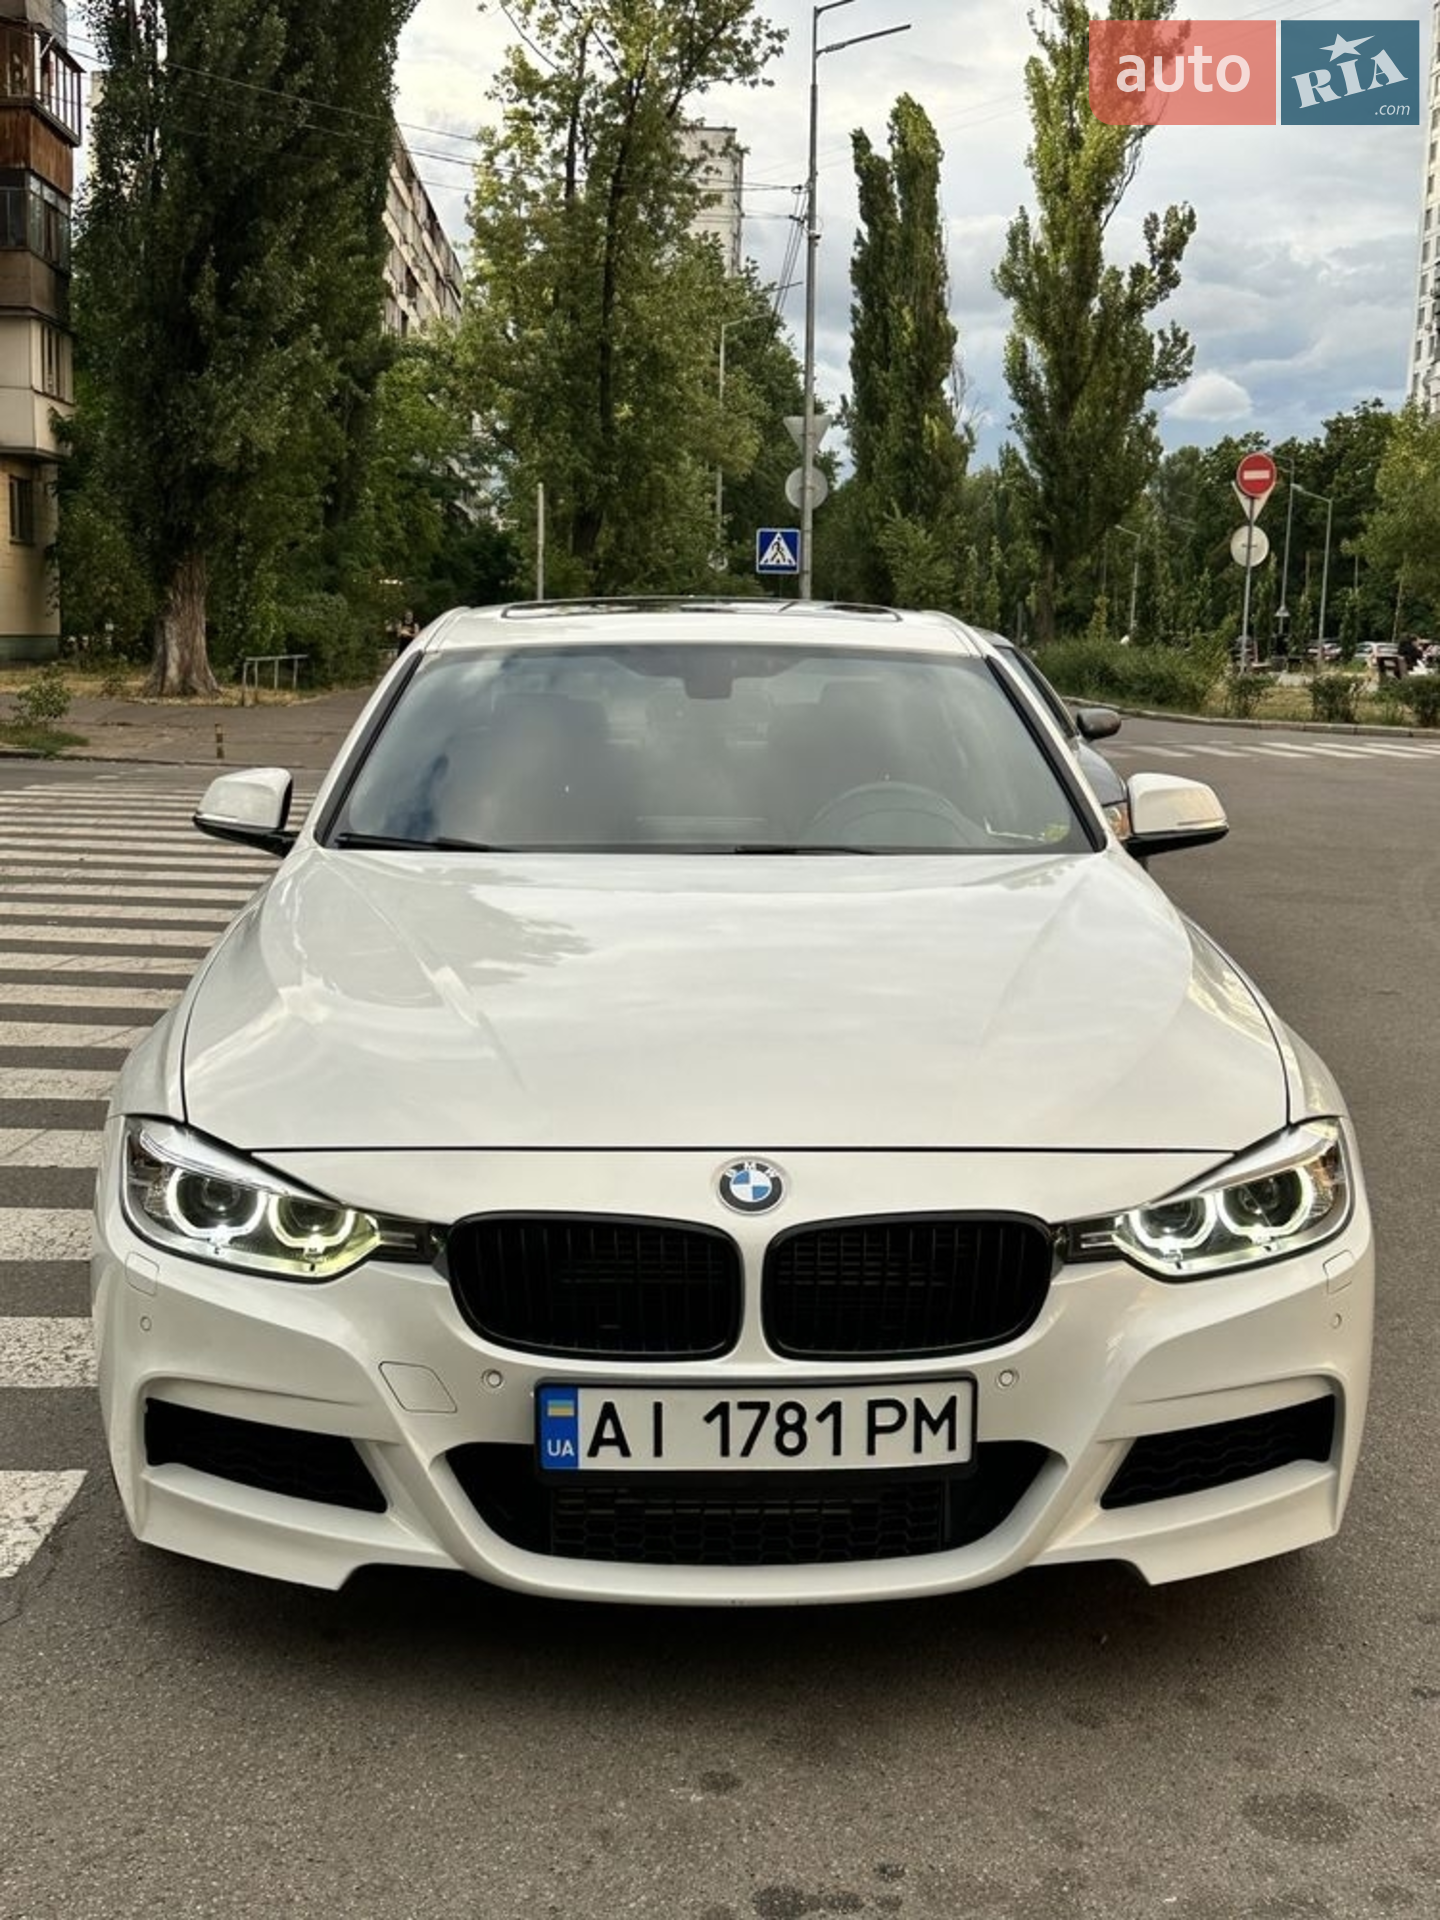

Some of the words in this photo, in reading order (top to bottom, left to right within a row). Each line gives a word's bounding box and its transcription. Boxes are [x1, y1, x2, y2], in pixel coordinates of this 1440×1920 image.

[587, 1401, 663, 1458] AI
[703, 1400, 842, 1458] 1781
[866, 1395, 958, 1456] PM
[547, 1439, 575, 1457] UA
